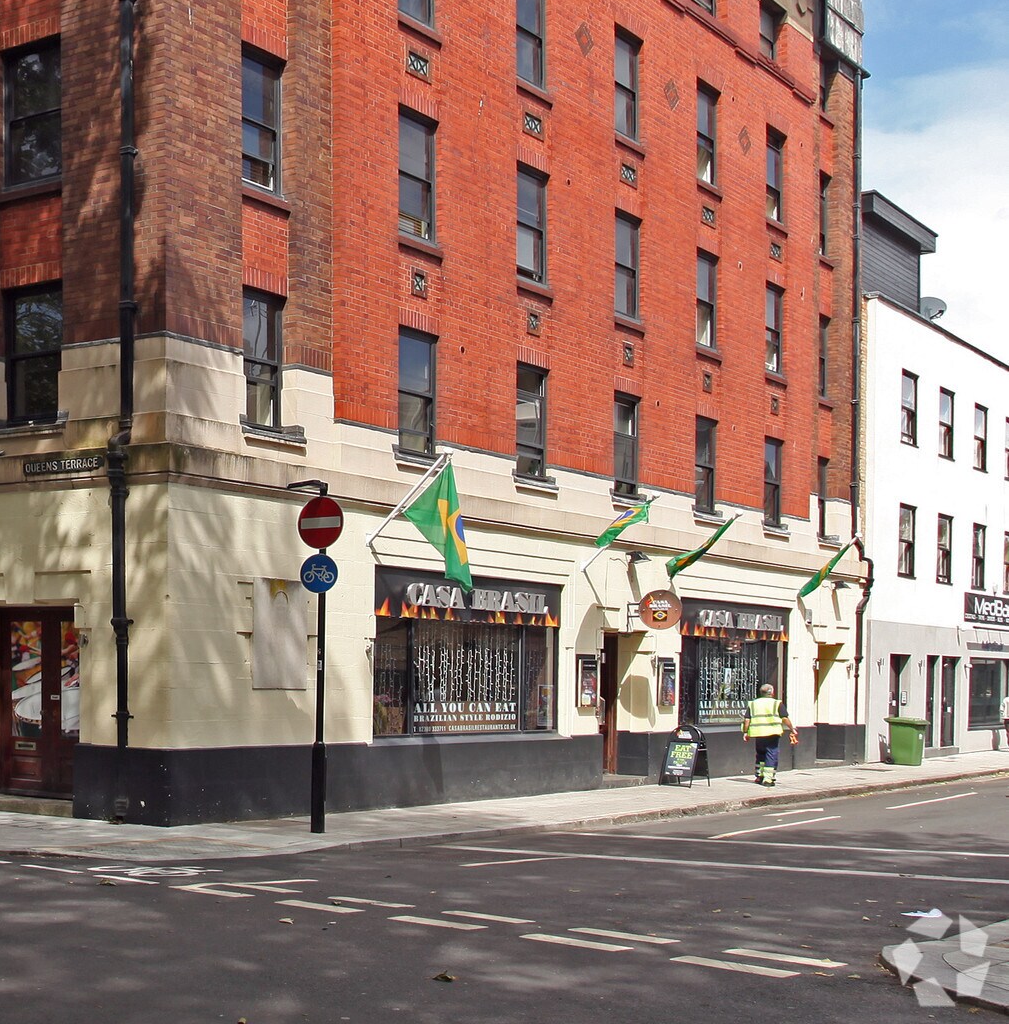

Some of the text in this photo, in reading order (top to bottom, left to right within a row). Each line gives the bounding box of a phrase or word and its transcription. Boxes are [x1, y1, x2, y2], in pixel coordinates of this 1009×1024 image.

[25, 457, 99, 473] QUEENS TERRACE
[406, 582, 549, 614] CASA BRASIL
[699, 609, 784, 632] CASA BRASIL
[413, 702, 517, 713] ALL YOU CAN EAT
[699, 700, 746, 709] ALL YOU CAN
[413, 714, 457, 722] BRAZILIAN
[485, 713, 516, 721] RODIZIO
[674, 744, 692, 752] EAT
[670, 751, 694, 759] FREE
